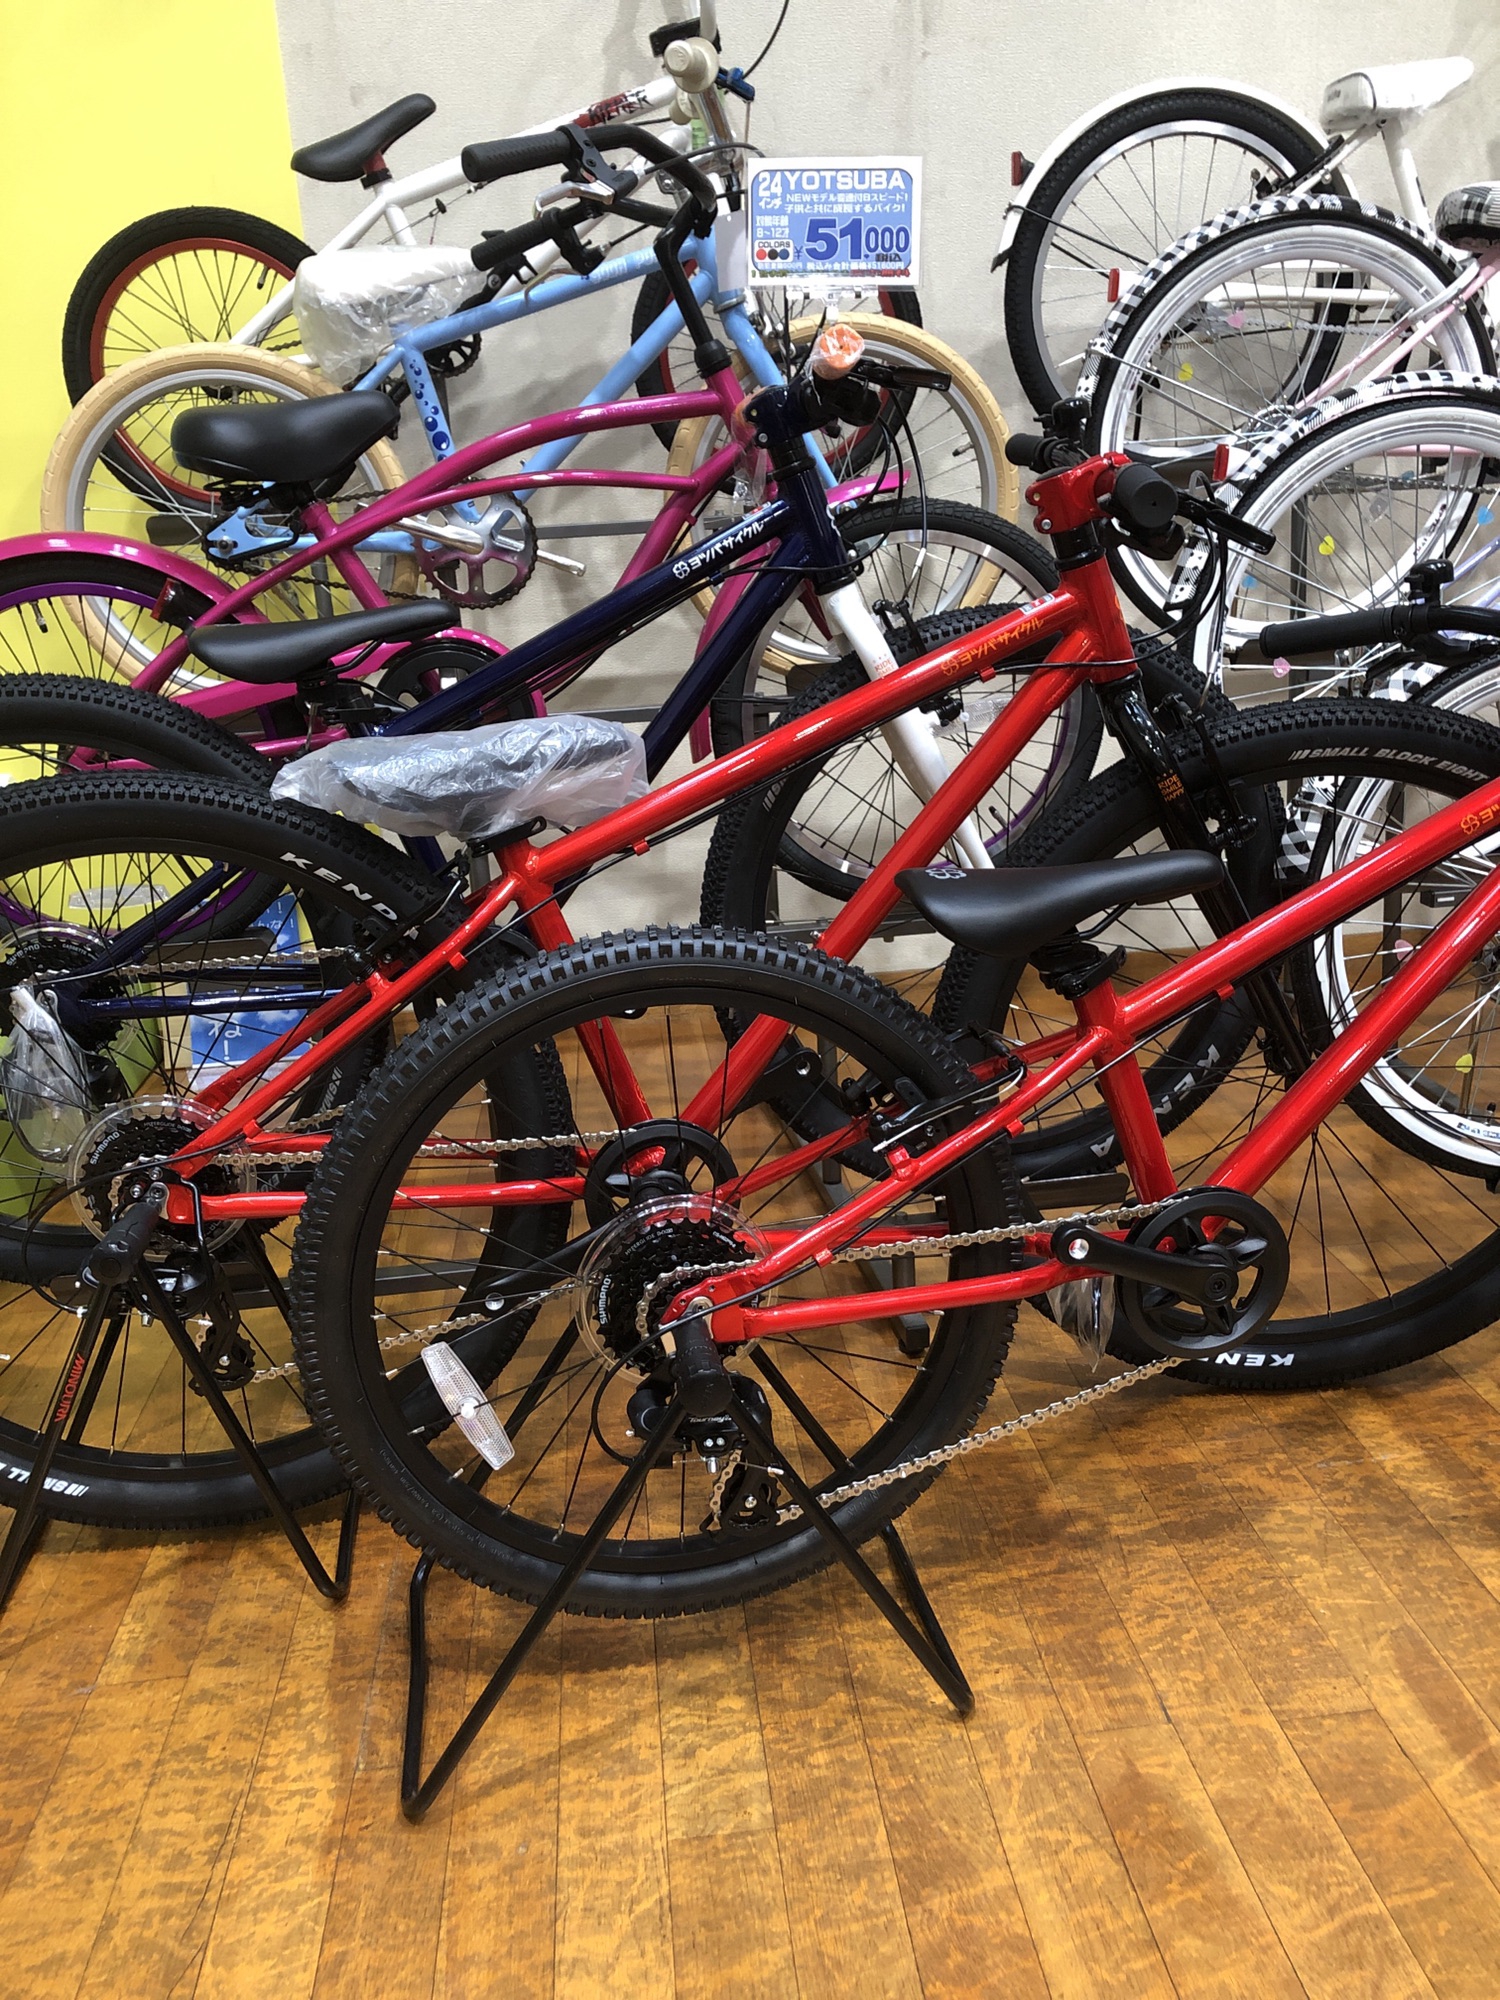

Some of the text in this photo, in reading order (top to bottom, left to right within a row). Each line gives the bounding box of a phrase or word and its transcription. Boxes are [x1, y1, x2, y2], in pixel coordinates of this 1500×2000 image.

[758, 170, 906, 197] 24 YOTSUBA
[758, 197, 783, 209] インチ
[758, 240, 791, 249] COLORS
[688, 520, 765, 570] ヨツバサイクル
[958, 616, 1046, 667] ヨツバサイクル
[1307, 746, 1491, 782] SMALL BLOCK EIGHT
[1157, 774, 1181, 790] RIDE
[1160, 780, 1183, 797] SMILE
[90, 1130, 121, 1165] SHIMANO
[598, 1277, 612, 1325] SHIMANO
[54, 1353, 86, 1422] MINOURA
